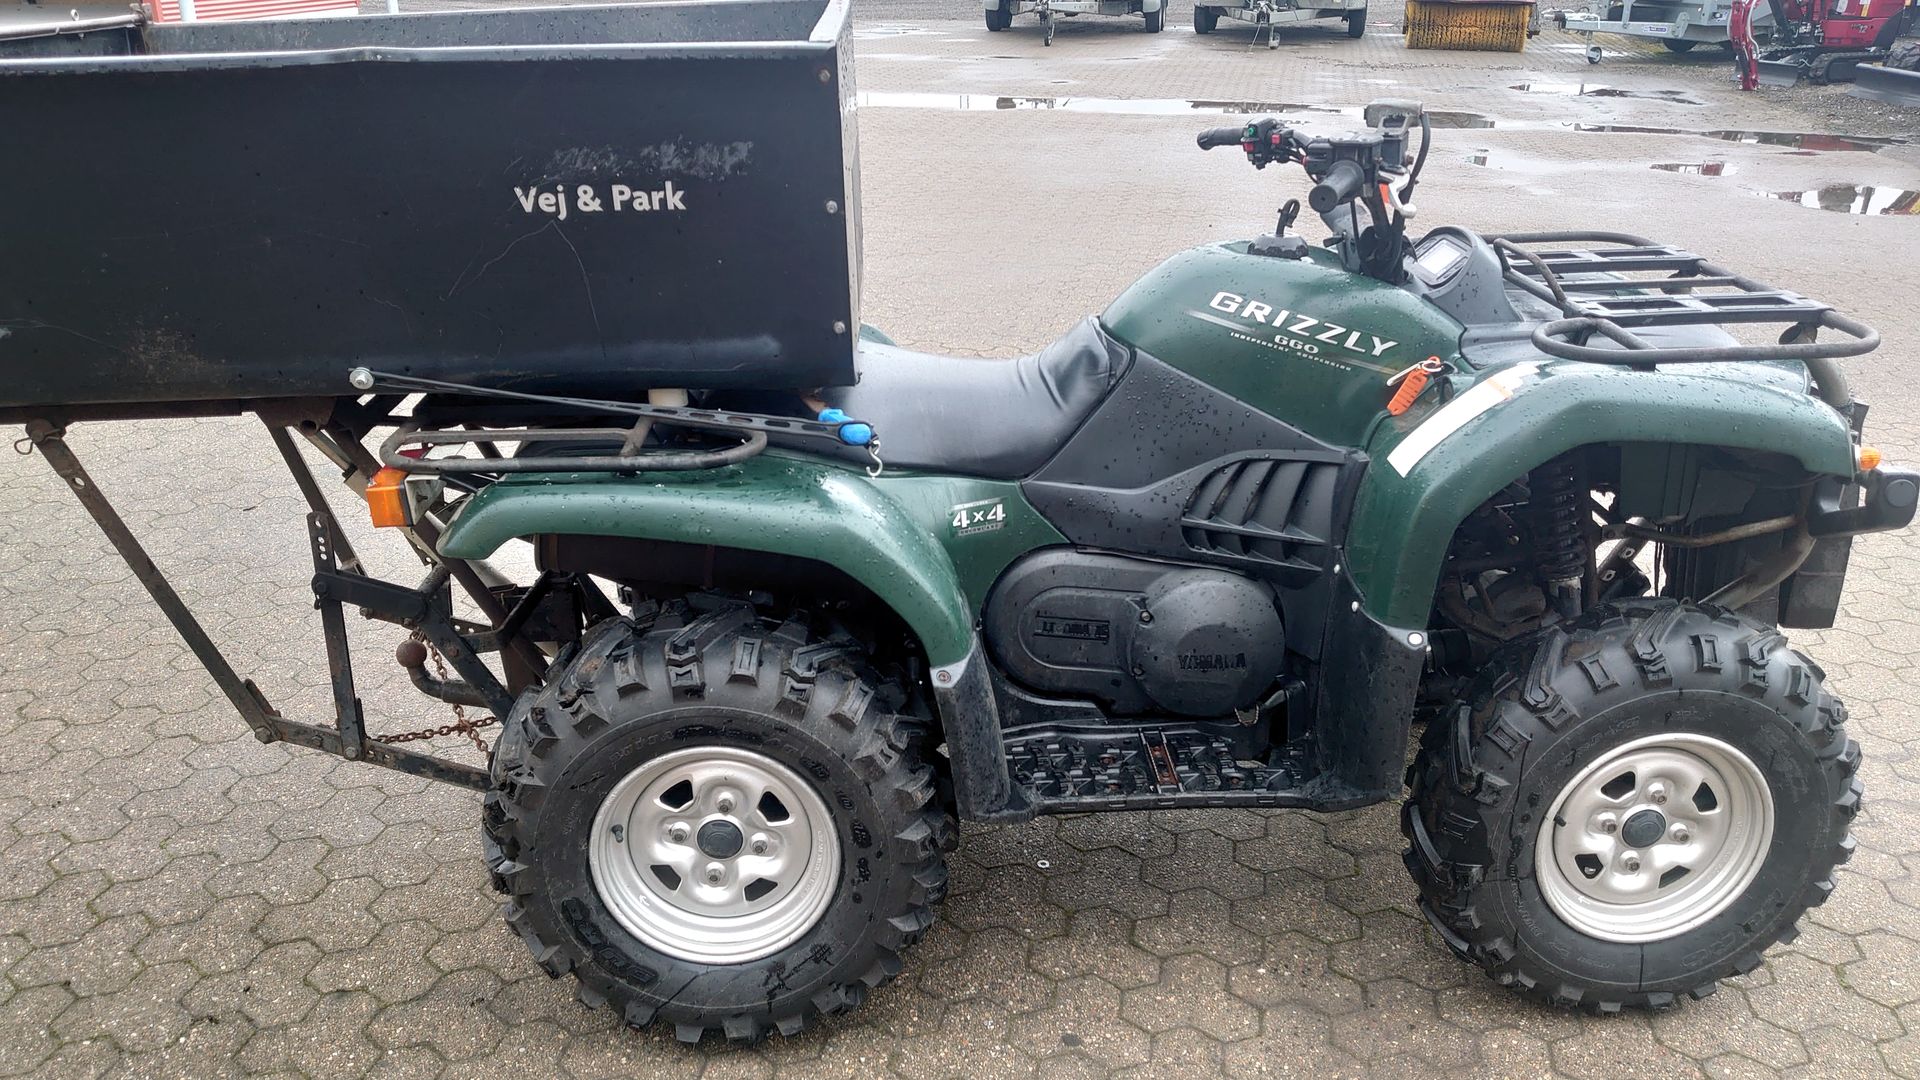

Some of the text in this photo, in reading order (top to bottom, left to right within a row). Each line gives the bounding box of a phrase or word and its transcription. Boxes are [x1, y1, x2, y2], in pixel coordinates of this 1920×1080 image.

[514, 181, 686, 220] Vej & Park
[1209, 291, 1399, 357] GRIZZLY
[952, 503, 1007, 528] 4x4
